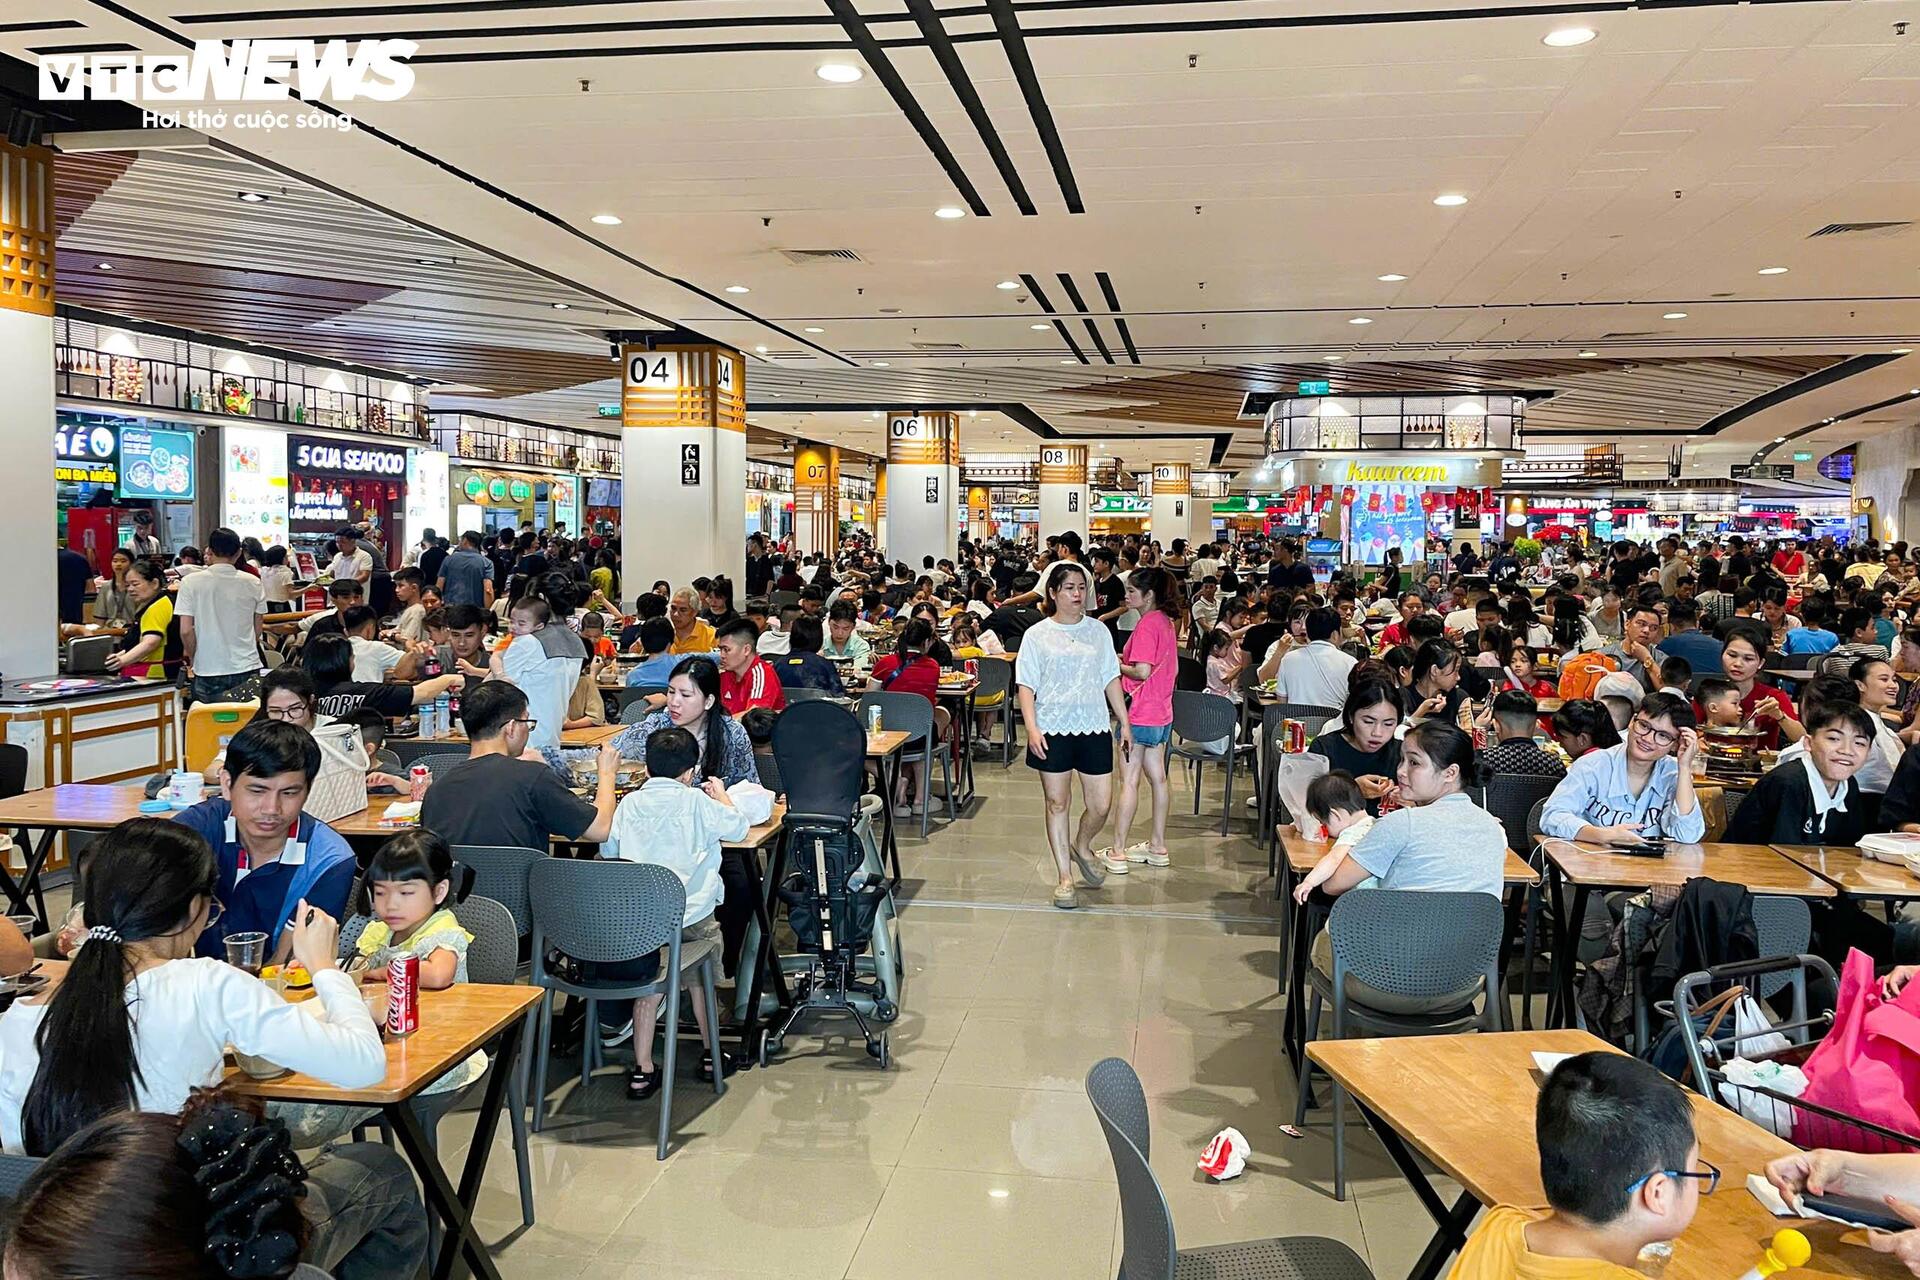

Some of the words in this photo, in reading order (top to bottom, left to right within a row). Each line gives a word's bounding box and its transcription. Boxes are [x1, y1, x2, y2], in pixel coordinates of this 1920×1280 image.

[630, 357, 669, 383] 04
[893, 419, 918, 437] 06
[311, 446, 341, 469] CUA
[343, 449, 404, 474] SEAFOOD
[1044, 450, 1063, 464] 08
[808, 465, 826, 478] 07
[1155, 467, 1169, 478] 10
[977, 494, 987, 503] 13
[318, 694, 366, 717] YORK
